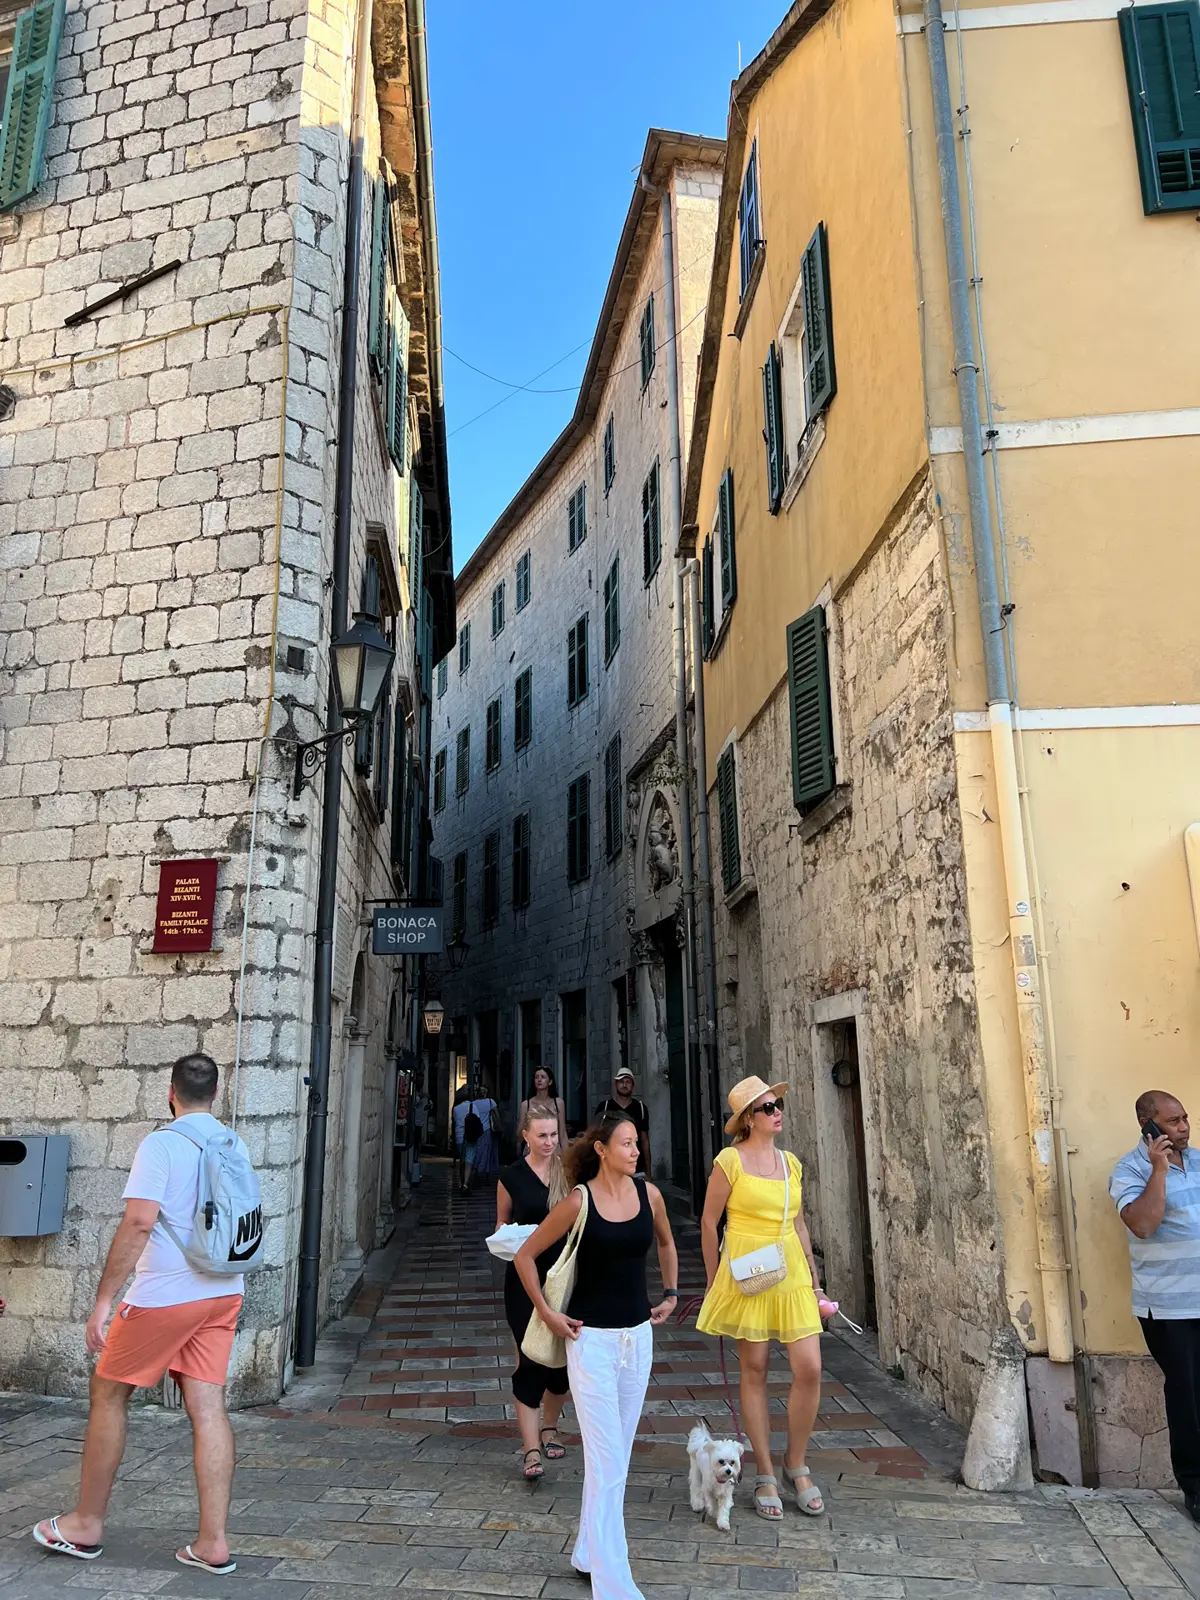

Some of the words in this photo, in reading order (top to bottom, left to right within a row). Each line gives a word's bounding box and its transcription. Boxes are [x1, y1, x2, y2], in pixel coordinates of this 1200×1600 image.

[377, 917, 437, 929] BONACA
[387, 932, 426, 944] SHOP
[235, 1203, 263, 1248] NIK
